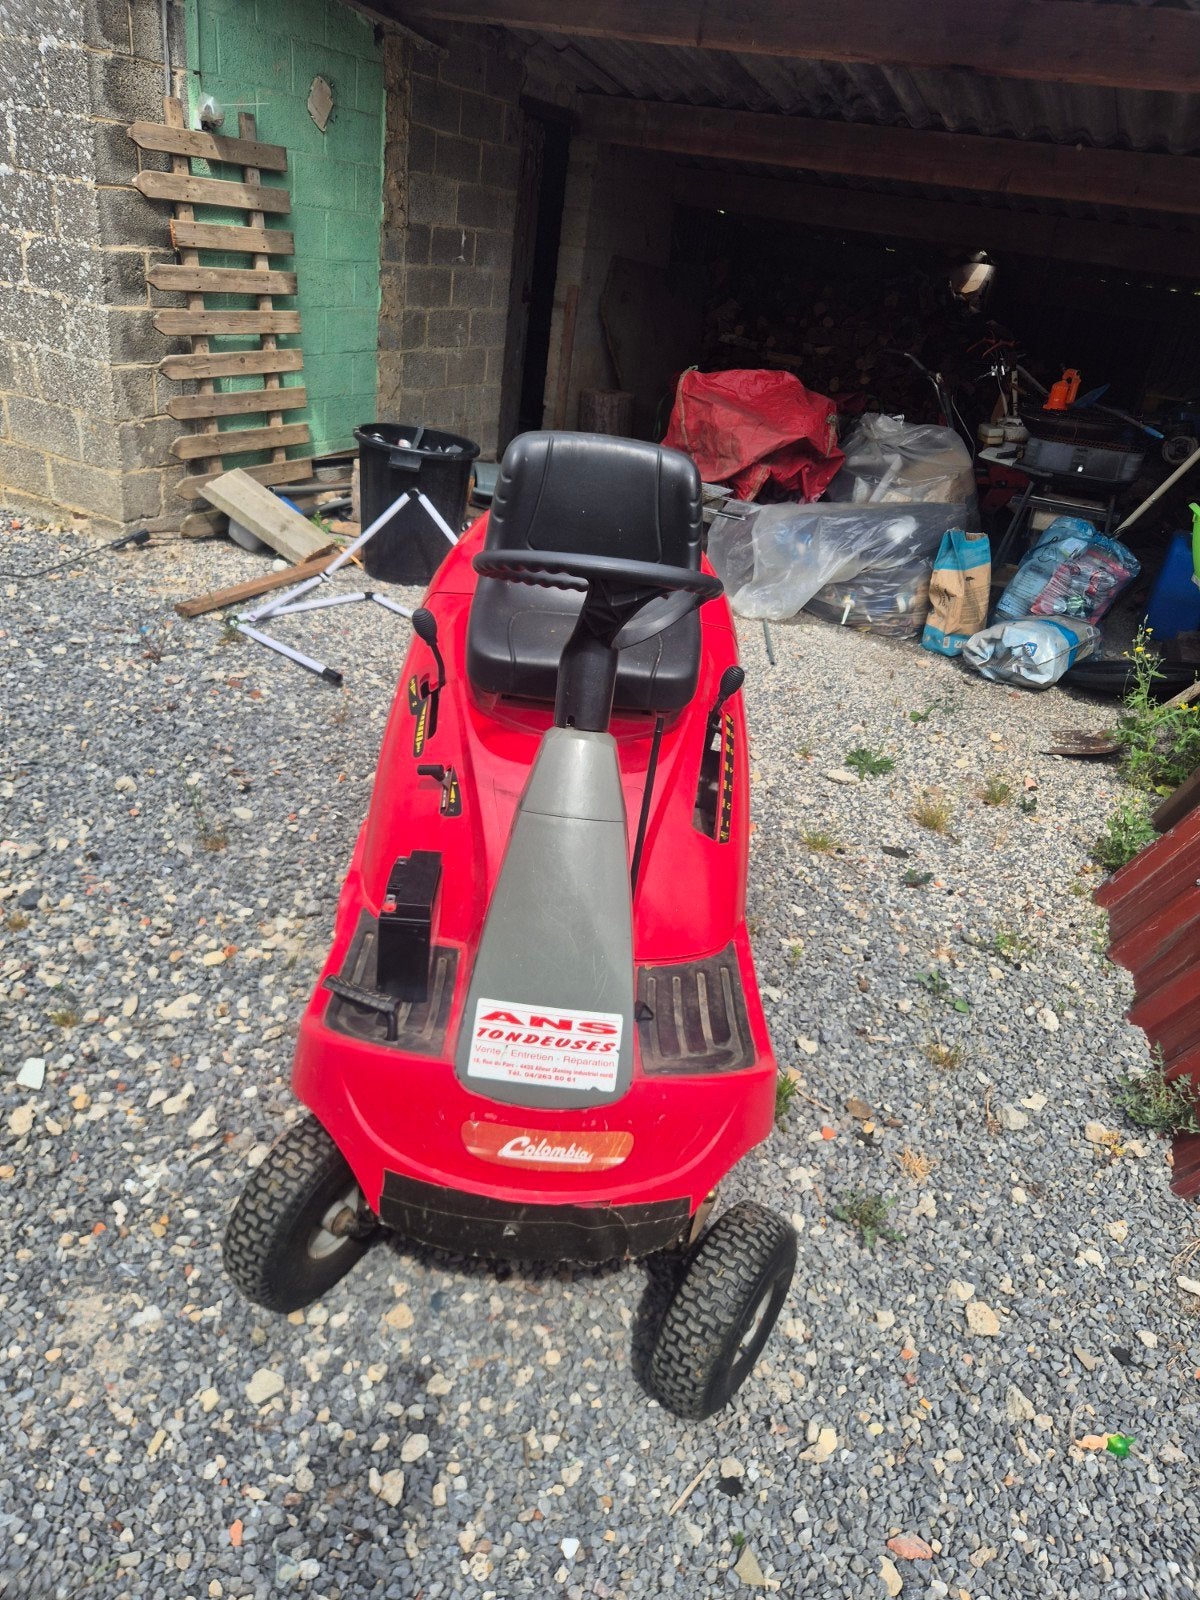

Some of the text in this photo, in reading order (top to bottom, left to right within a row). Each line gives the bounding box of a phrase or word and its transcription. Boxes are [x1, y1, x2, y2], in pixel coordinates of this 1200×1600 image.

[480, 1011, 618, 1034] ANS
[477, 1027, 616, 1052] TONDEUSES
[475, 1043, 501, 1055] Vente
[511, 1049, 553, 1062] Entretien
[497, 1136, 594, 1163] Colombia
